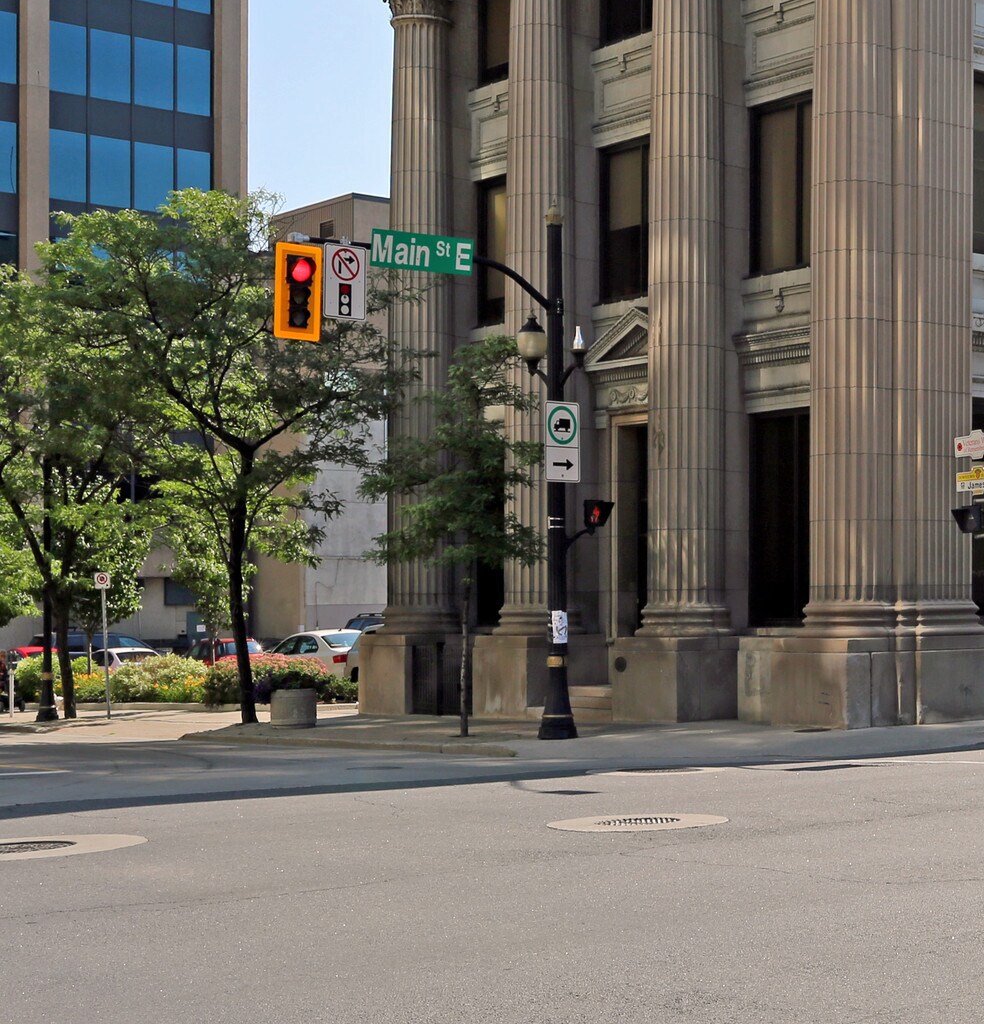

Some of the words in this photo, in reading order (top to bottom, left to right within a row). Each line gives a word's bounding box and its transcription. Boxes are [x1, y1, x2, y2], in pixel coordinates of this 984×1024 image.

[372, 233, 430, 267] Main
[436, 241, 451, 257] St
[456, 242, 471, 271] E
[968, 481, 984, 489] James
